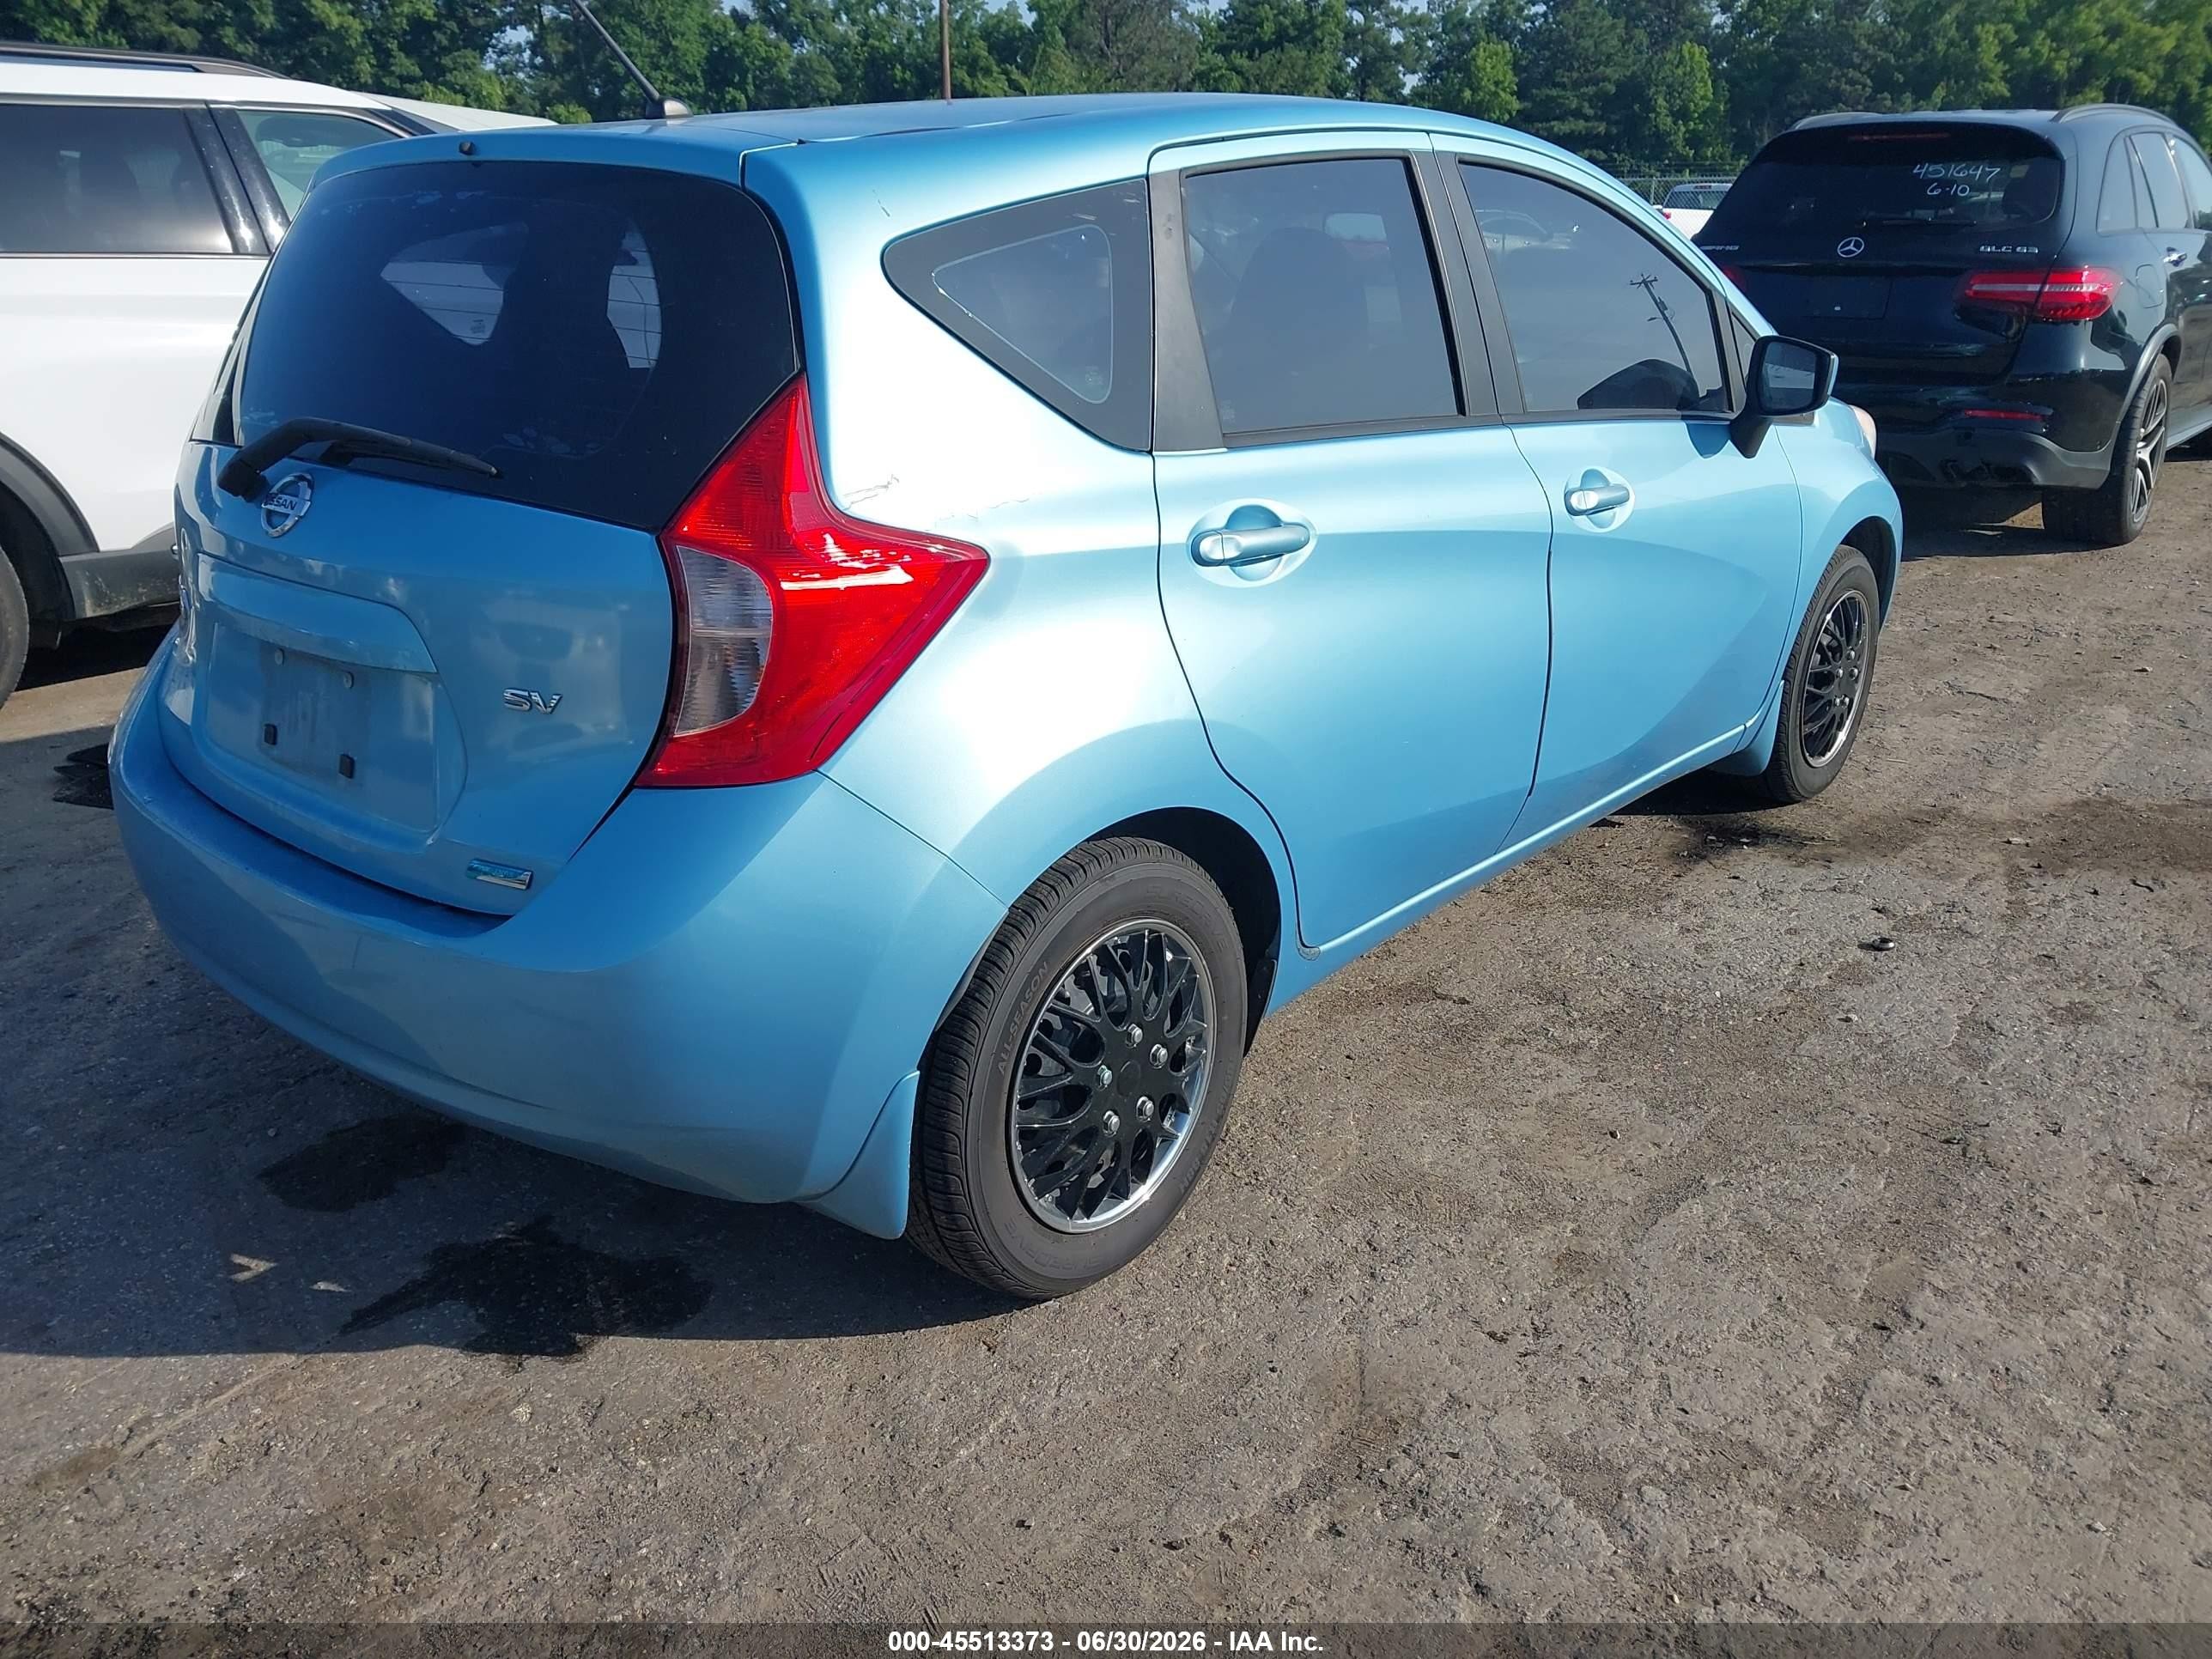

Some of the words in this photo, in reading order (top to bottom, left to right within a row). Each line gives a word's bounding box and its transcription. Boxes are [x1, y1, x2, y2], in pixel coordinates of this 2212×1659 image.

[1912, 162, 2001, 182] 451647
[264, 495, 297, 511] SSAN
[503, 687, 562, 714] SV
[997, 961, 1049, 1075] ALL-SEASON
